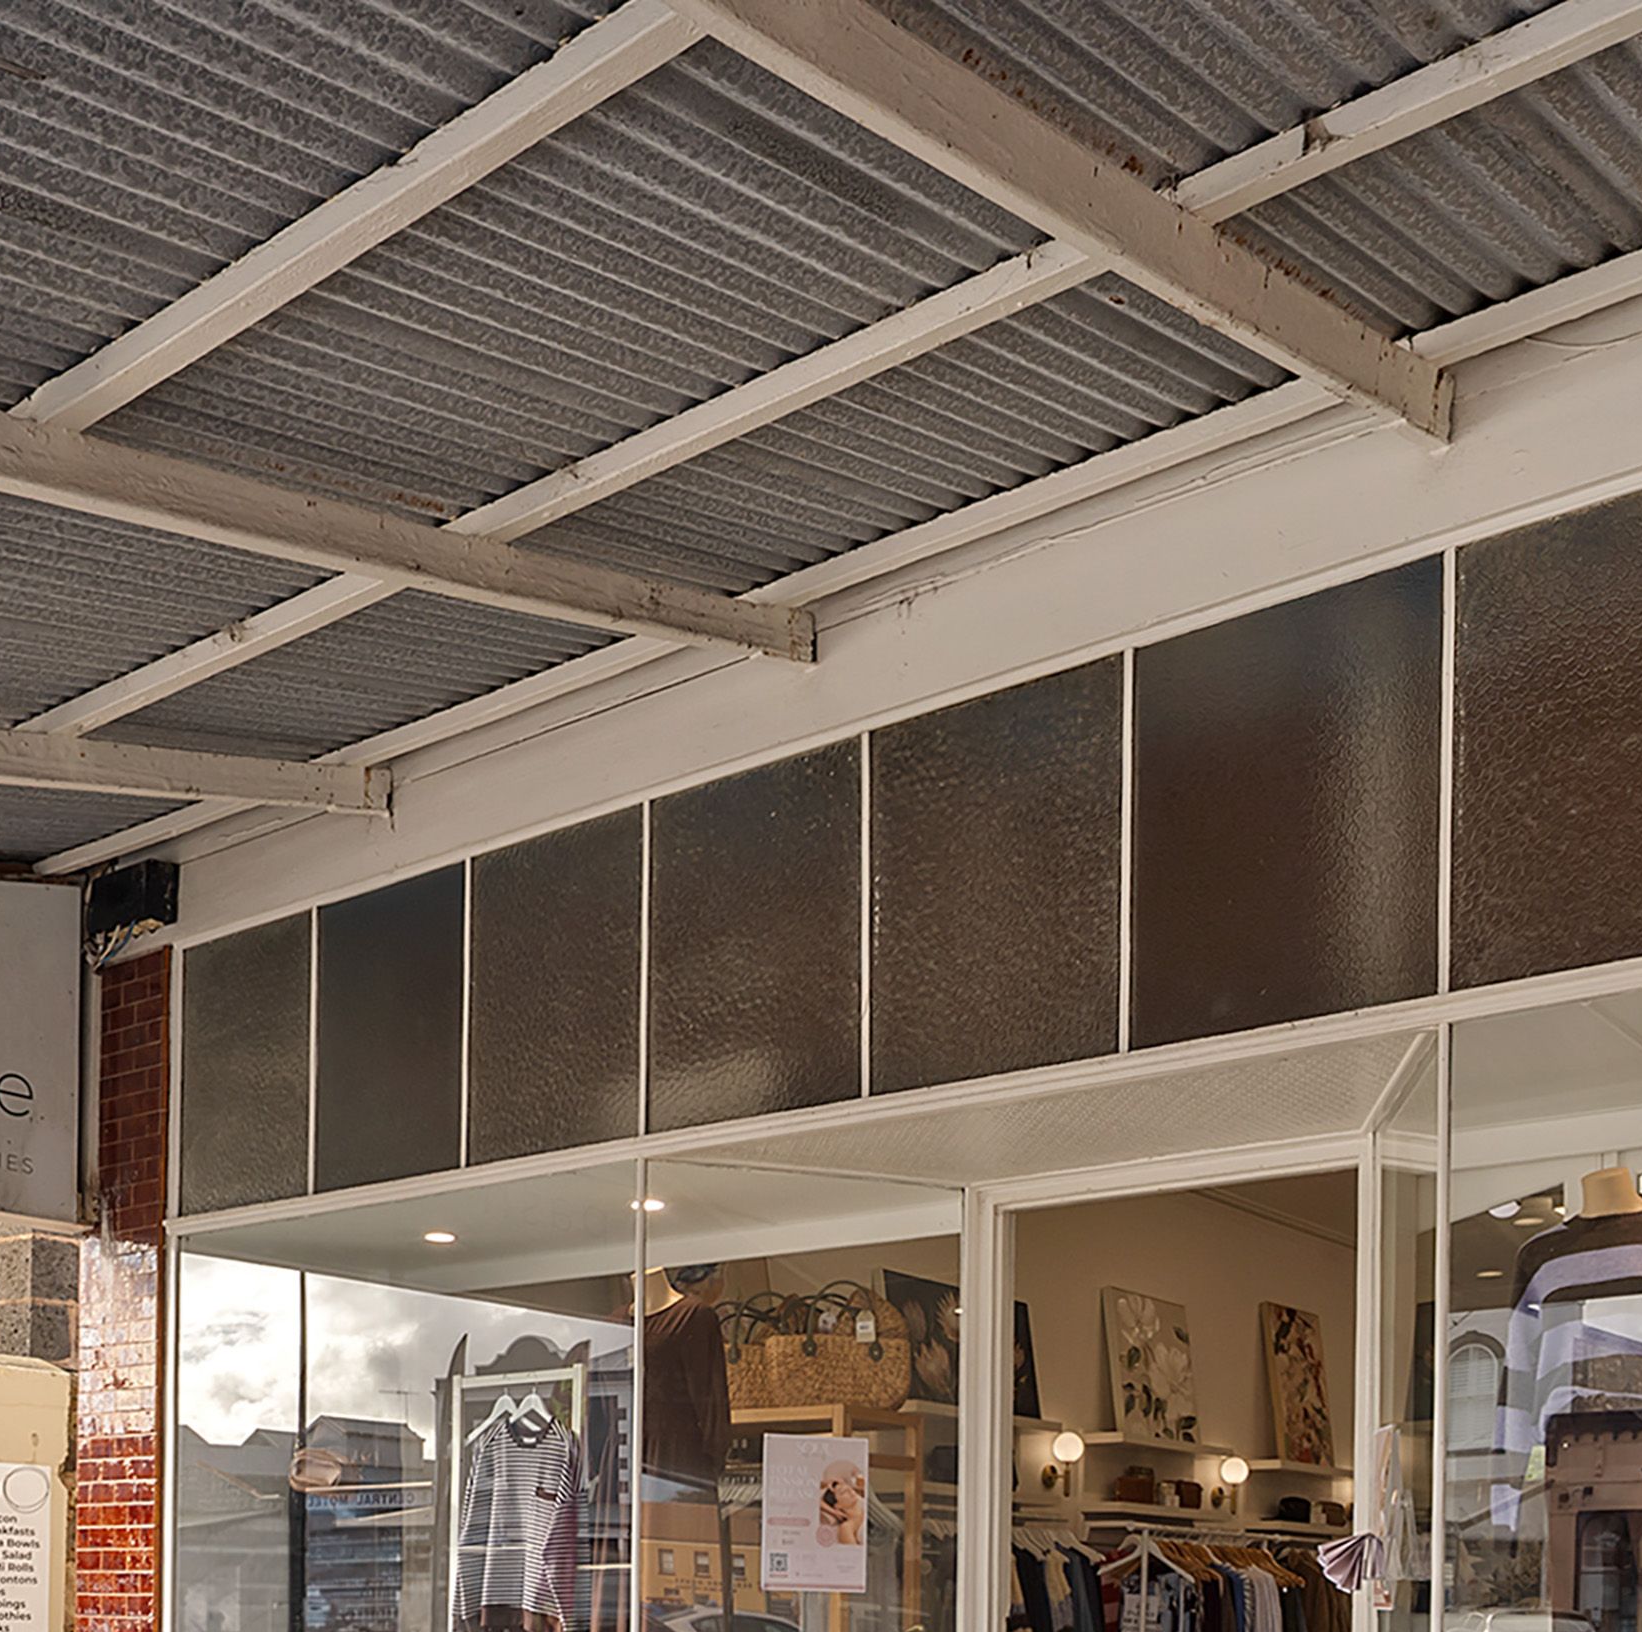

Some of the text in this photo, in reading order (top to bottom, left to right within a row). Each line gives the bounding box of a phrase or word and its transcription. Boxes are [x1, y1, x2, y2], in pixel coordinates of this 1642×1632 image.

[7, 1539, 40, 1548] Bowls
[2, 1551, 32, 1560] Salad
[8, 1563, 34, 1572] Rolls
